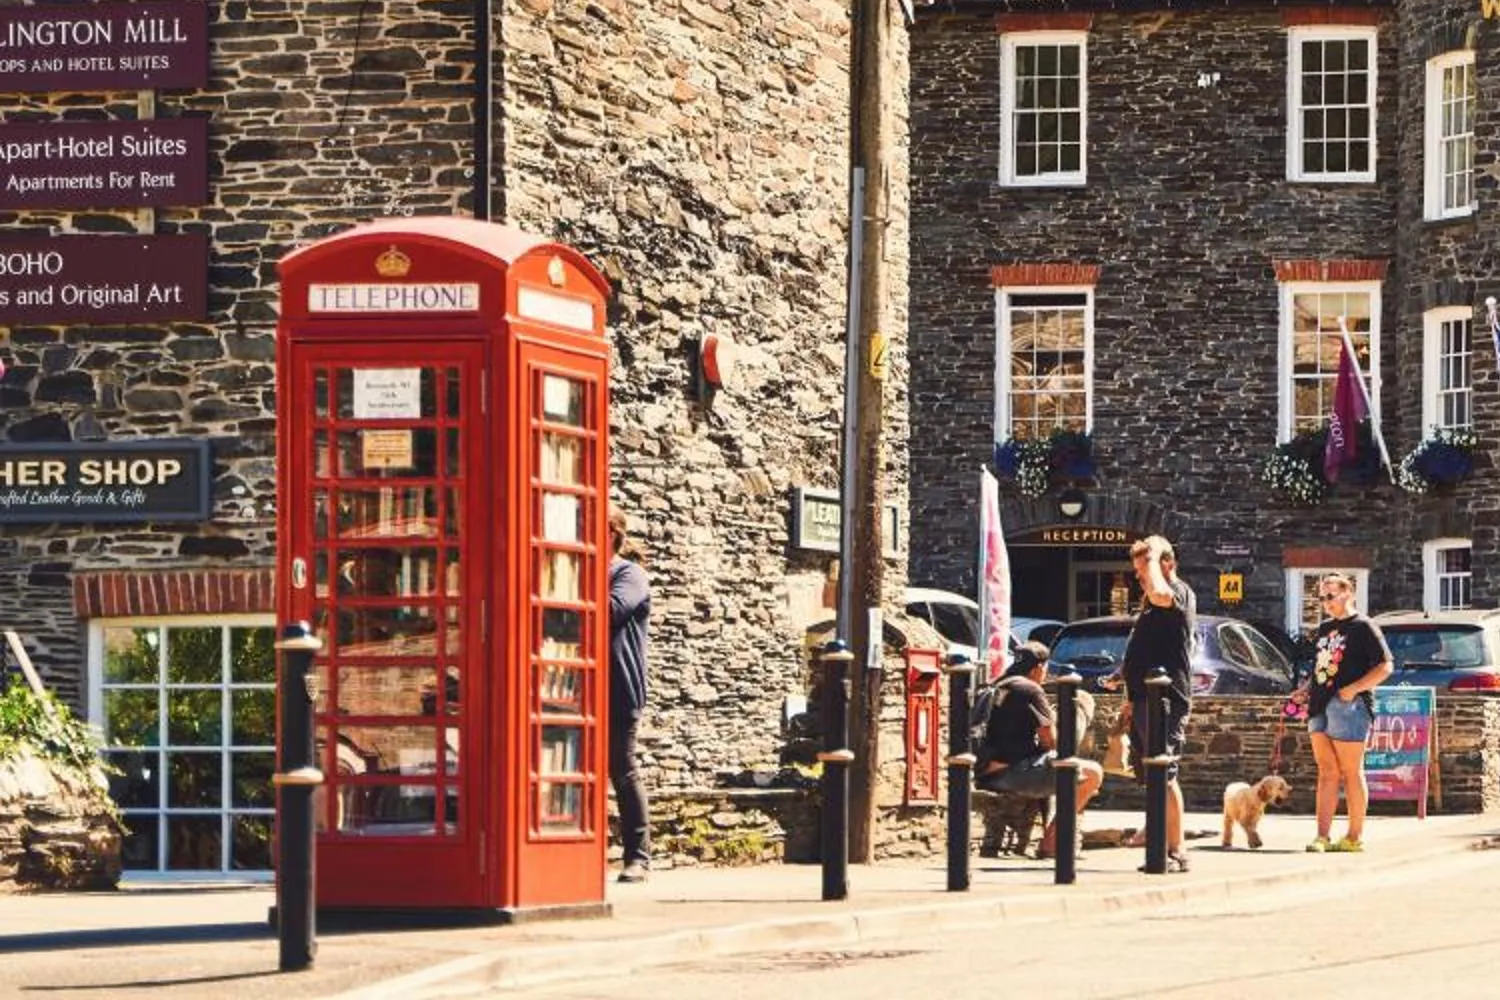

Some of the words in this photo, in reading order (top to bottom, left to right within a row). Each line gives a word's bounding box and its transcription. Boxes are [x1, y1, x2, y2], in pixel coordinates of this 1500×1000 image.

[124, 18, 188, 43] MILL
[31, 58, 63, 72] AND
[67, 57, 115, 71] HOTEL
[119, 55, 170, 70] SUITES
[121, 135, 187, 157] Suites
[5, 173, 104, 193] Apartments
[108, 171, 135, 189] For
[139, 171, 177, 188] Rent
[16, 284, 53, 305] and
[60, 283, 139, 309] Original
[147, 282, 183, 303] Art
[319, 286, 473, 308] TELEPHONE
[79, 458, 182, 486] SHOP
[29, 488, 70, 505] Leather
[71, 487, 105, 507] Goods
[105, 491, 118, 505] &
[121, 487, 147, 509] Gifts
[1043, 529, 1127, 541] RECEPTION
[1224, 581, 1239, 592] AA
